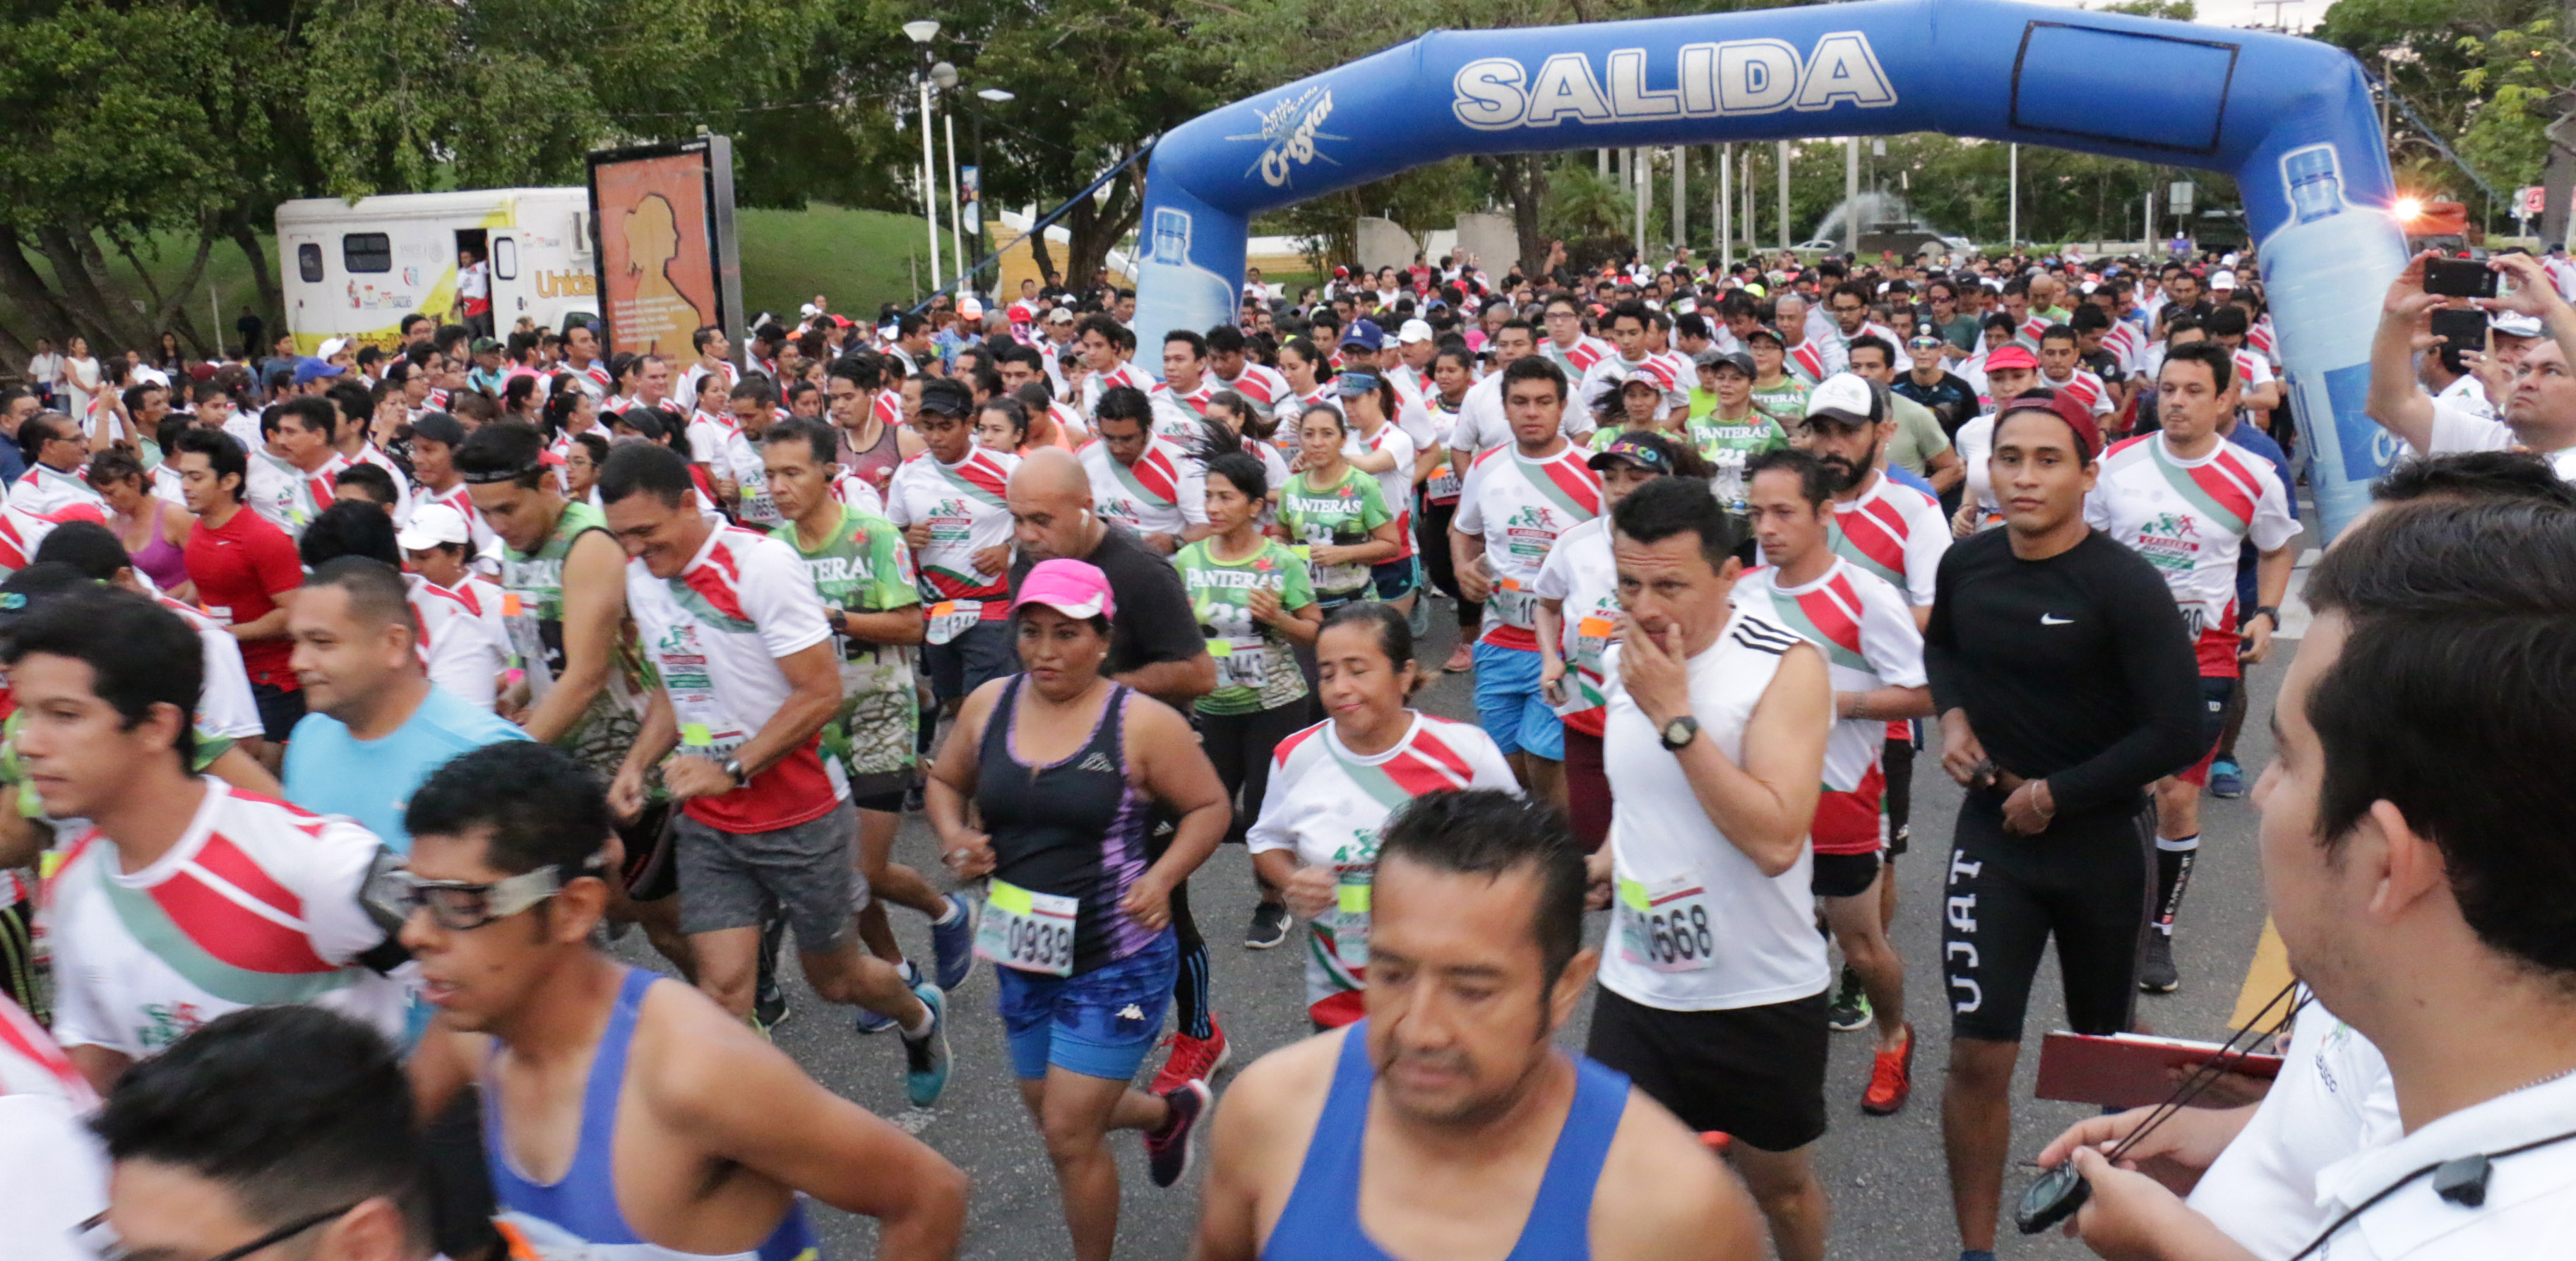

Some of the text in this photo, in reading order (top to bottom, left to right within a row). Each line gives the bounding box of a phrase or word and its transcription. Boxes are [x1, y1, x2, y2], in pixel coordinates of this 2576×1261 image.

[1453, 31, 1898, 131] SALIDA
[1262, 90, 1333, 186] Cristal
[1693, 425, 1772, 443] PANTERAS
[1286, 494, 1363, 515] PANTERAS
[2144, 536, 2193, 550] CARRERA
[1186, 568, 1285, 591] PANTERAS
[1010, 916, 1070, 967] 0939
[1947, 849, 1983, 1014] UJAT
